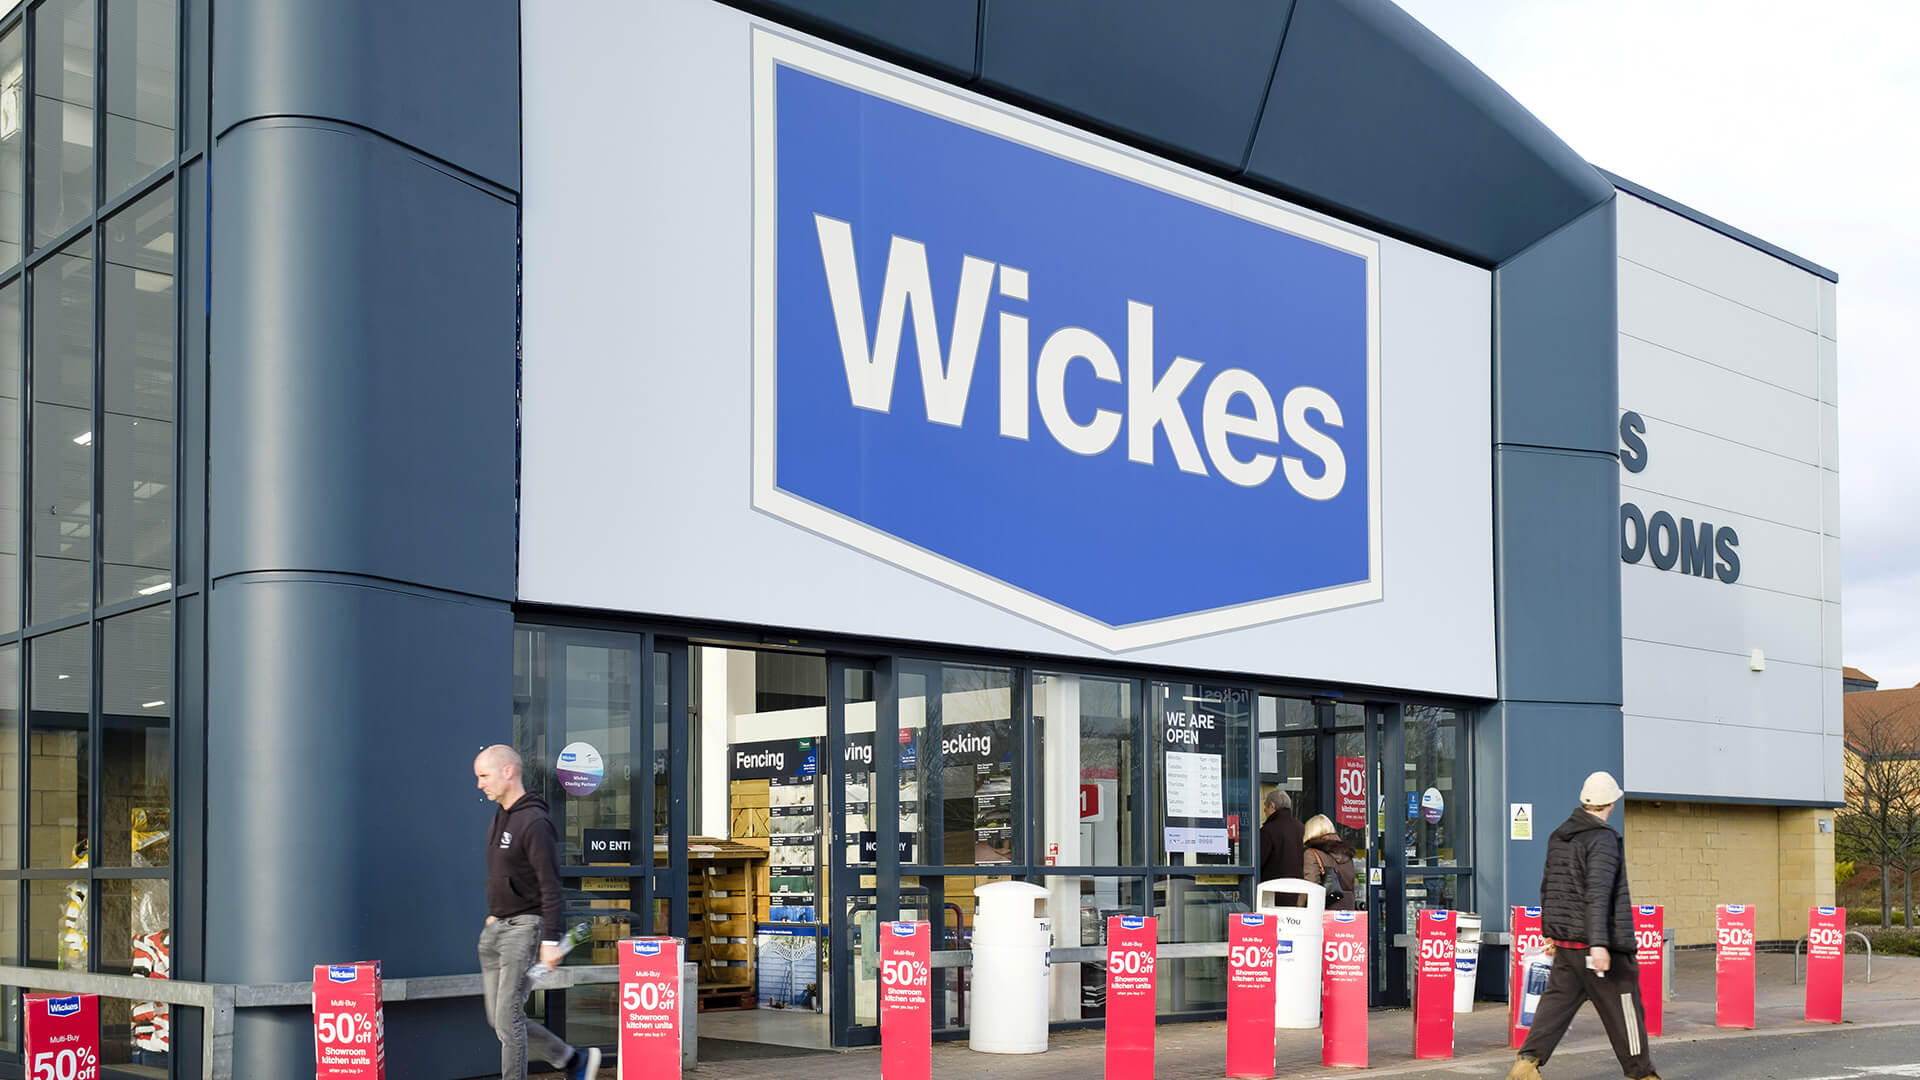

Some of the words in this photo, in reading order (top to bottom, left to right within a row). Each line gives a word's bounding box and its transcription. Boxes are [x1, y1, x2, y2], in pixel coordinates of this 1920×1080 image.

[812, 211, 1348, 501] Wickes
[1619, 410, 1648, 474] S
[1620, 502, 1741, 584] OOMS
[1166, 711, 1186, 727] WE
[1189, 714, 1215, 729] ARE
[942, 733, 991, 756] ecking
[1166, 728, 1199, 744] OPEN
[736, 749, 784, 771] Fencing
[844, 742, 872, 764] ving
[591, 840, 607, 851] NO
[1286, 917, 1301, 925] You
[1718, 928, 1752, 945] 50%
[1809, 928, 1842, 945] 50%
[893, 949, 915, 957] Multi-Buy
[1230, 946, 1274, 968] 50%
[1260, 959, 1273, 968] off
[1324, 941, 1366, 962] 50%
[1352, 954, 1364, 962] off
[1421, 939, 1454, 959] 50%
[1443, 951, 1453, 959] off
[1109, 950, 1154, 974] 50%
[1140, 964, 1154, 974] off
[330, 970, 355, 978] Wickes
[635, 970, 661, 978] Multi-Buy
[882, 960, 927, 986] 50%
[913, 976, 927, 986] off
[623, 982, 675, 1011] 50%
[658, 999, 675, 1010] off
[884, 994, 908, 1002] kitchen
[909, 995, 926, 1003] units
[887, 987, 922, 996] Showroom
[50, 1002, 78, 1012] Wickes
[330, 1000, 357, 1008] Multi-Buy
[626, 1021, 653, 1030] kitchen
[654, 1022, 673, 1030] units
[629, 1013, 669, 1021] Showroom
[318, 1012, 372, 1044] 50%
[355, 1031, 372, 1044] off
[49, 1034, 80, 1043] Multi-Buy
[325, 1047, 366, 1056] Showroom
[33, 1046, 96, 1080] 50%
[77, 1066, 96, 1080] off
[321, 1056, 350, 1065] kitchen
[351, 1056, 371, 1065] units
